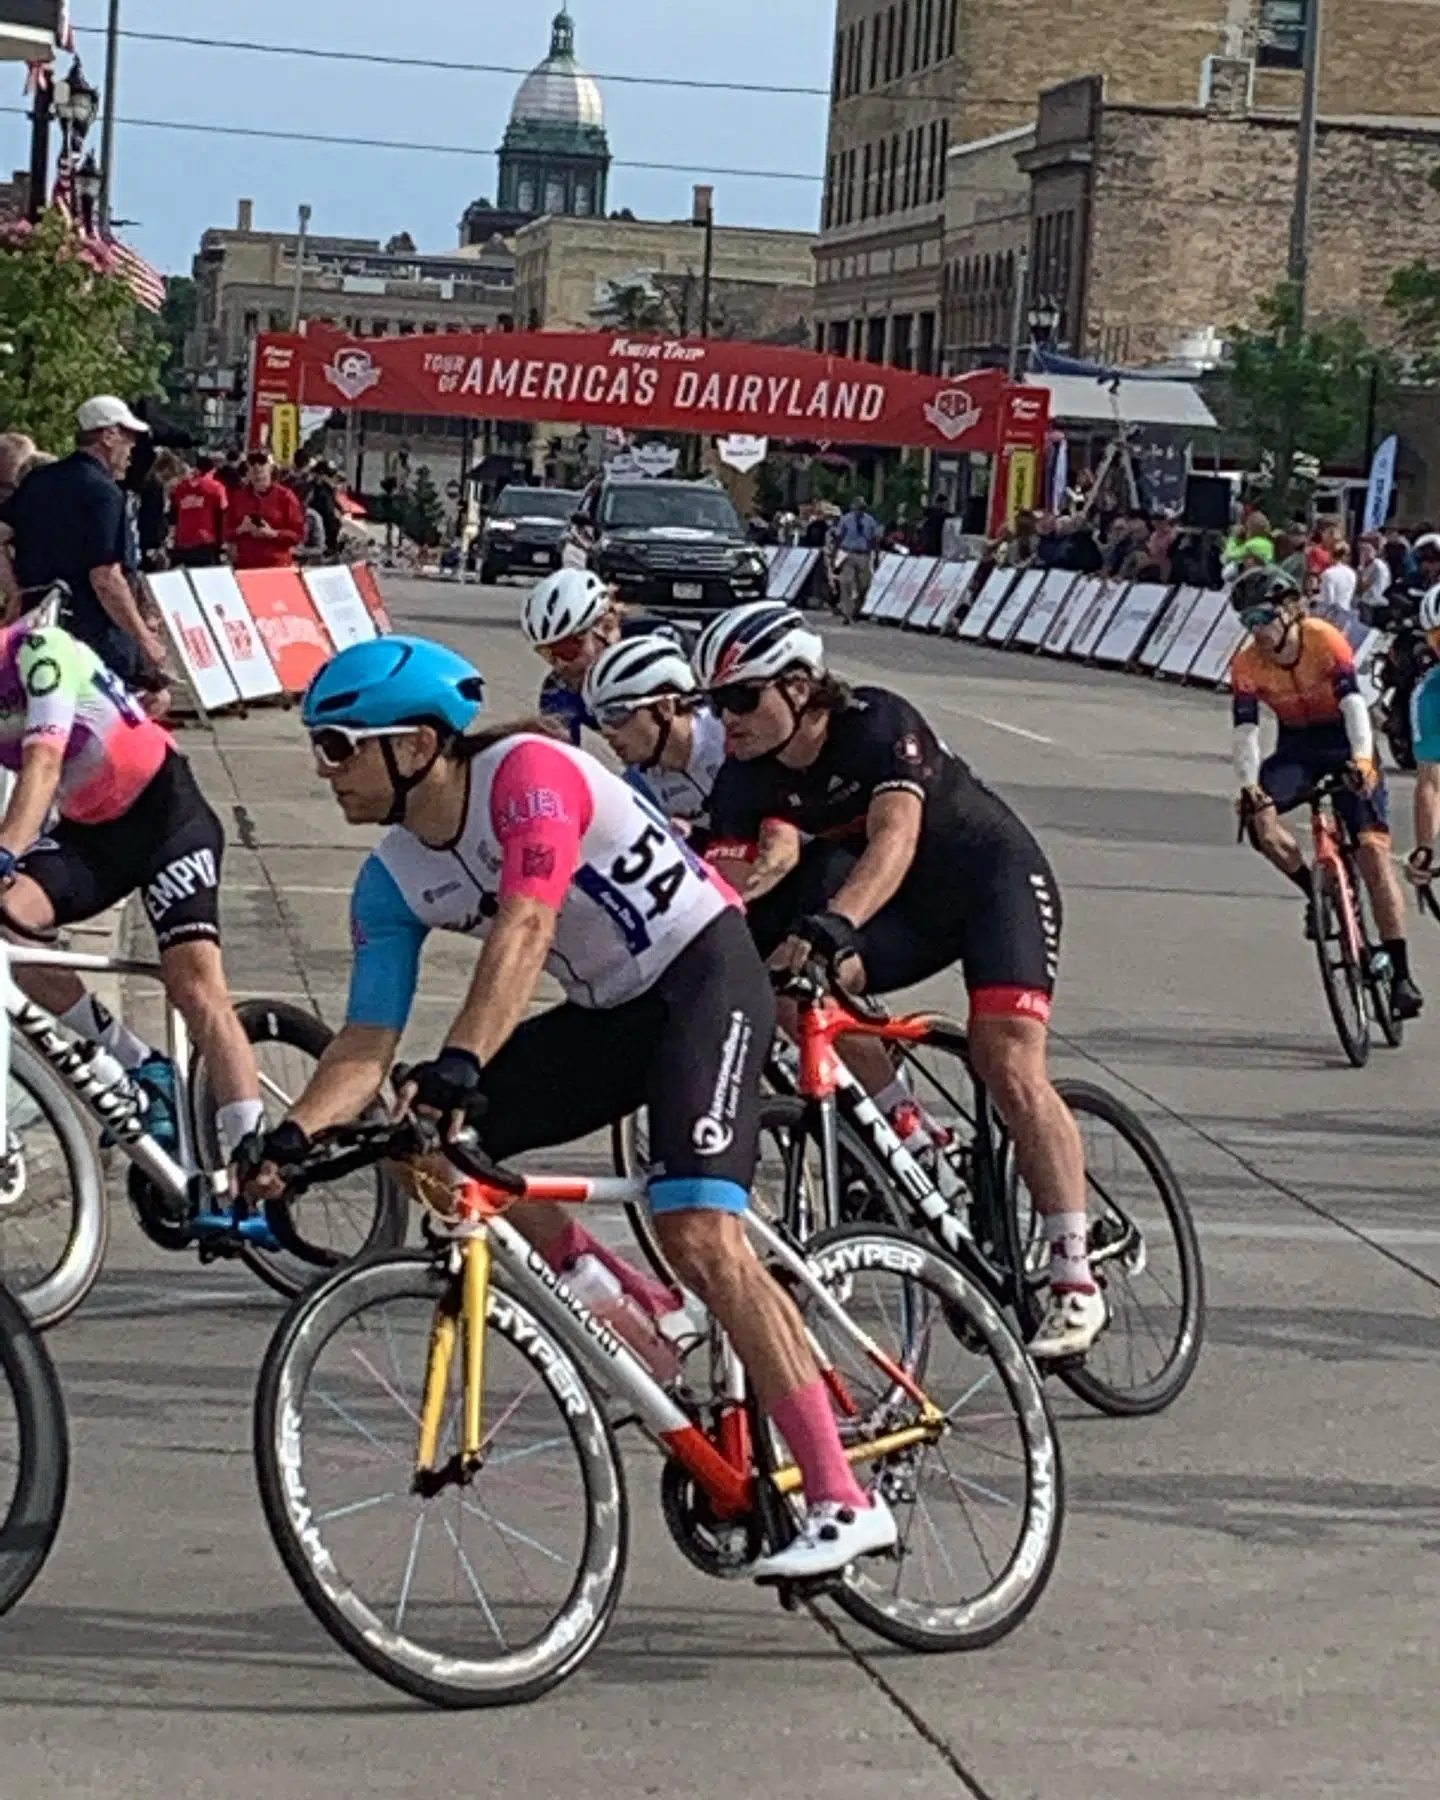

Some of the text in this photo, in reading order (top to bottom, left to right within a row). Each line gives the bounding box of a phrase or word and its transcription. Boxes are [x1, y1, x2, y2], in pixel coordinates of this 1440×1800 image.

[423, 353, 467, 375] TOUR
[438, 374, 460, 393] OF
[460, 356, 885, 422] AMERICA'S DAIRYLAND
[611, 824, 686, 921] 54
[830, 1050, 974, 1251] TREK
[821, 1243, 924, 1277] HYPER
[485, 1296, 586, 1416] HYPER
